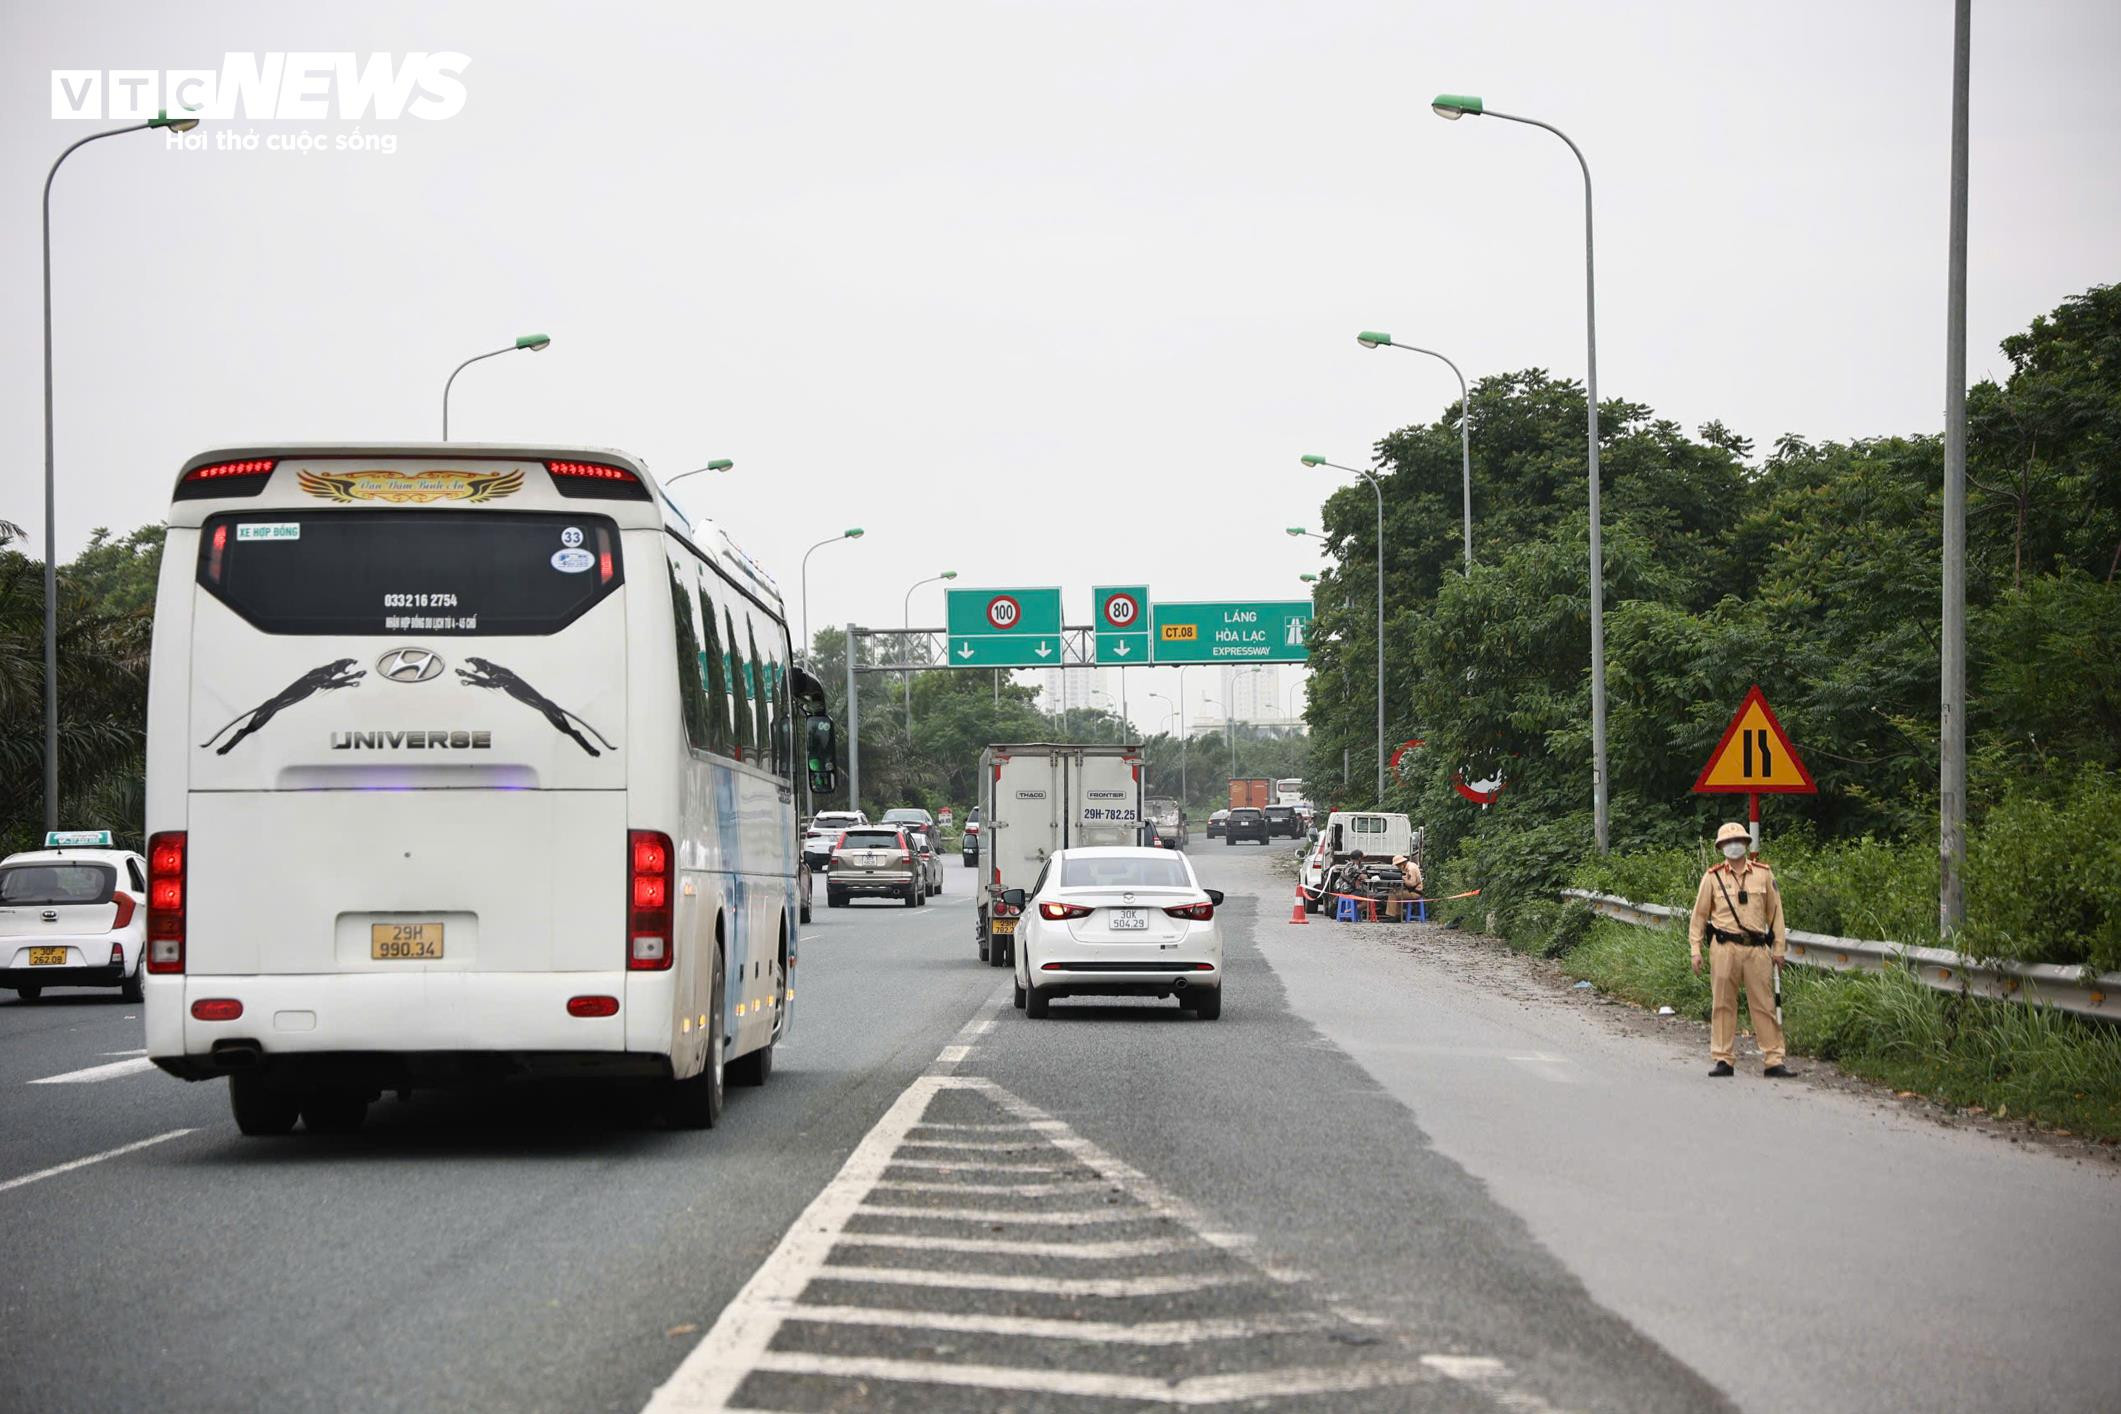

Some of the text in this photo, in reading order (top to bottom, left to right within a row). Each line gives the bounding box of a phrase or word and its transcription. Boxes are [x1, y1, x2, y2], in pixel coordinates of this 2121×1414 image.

[240, 528, 251, 537] XE
[564, 531, 581, 543] 33
[430, 593, 458, 607] 2754
[994, 604, 1013, 620] 100
[1113, 602, 1129, 618] 80
[1224, 609, 1257, 623] LÁNG
[1165, 626, 1193, 638] CT.08
[1215, 627, 1266, 644] HÒA LẠC
[1212, 646, 1271, 656] EXPRESSWAY
[331, 730, 491, 749] UNIVERSE
[1084, 808, 1136, 821] 29H-782.25
[1120, 910, 1137, 919] 30K
[1113, 919, 1145, 928] 504.29
[392, 926, 423, 941] 29H
[380, 942, 435, 957] 990.34
